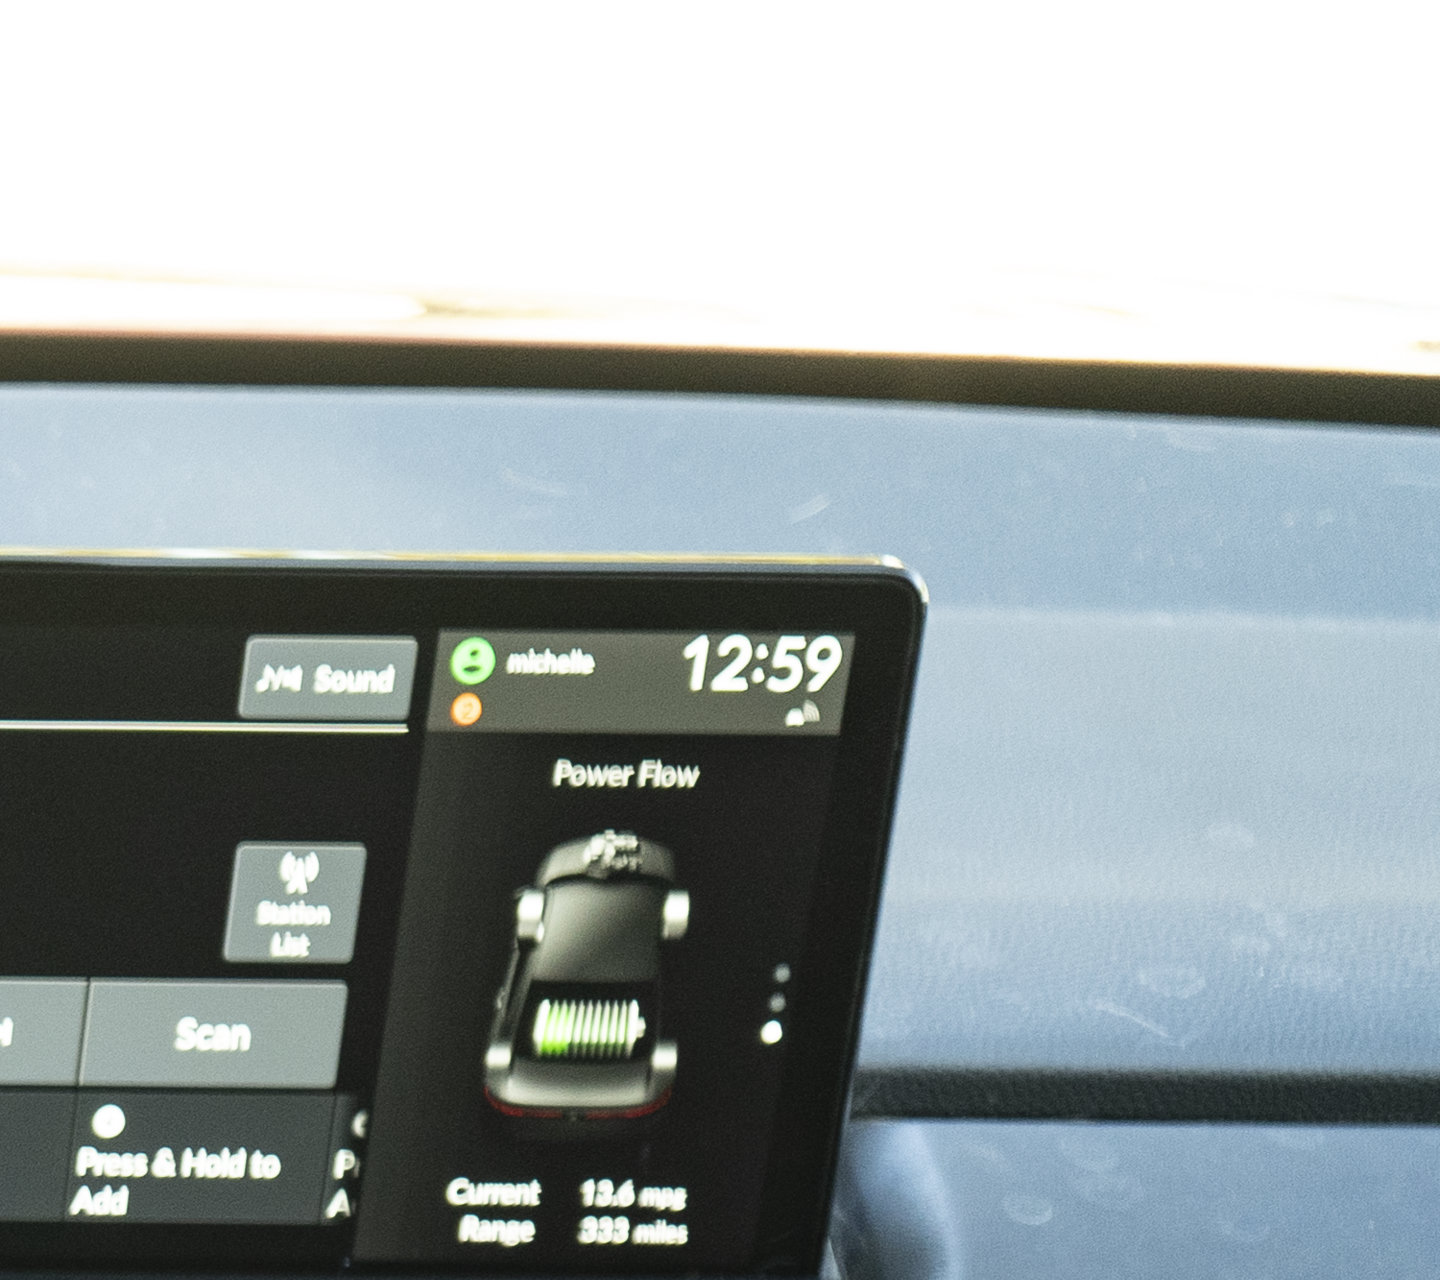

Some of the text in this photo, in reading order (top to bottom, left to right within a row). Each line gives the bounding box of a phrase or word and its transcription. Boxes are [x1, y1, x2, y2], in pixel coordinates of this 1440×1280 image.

[313, 664, 396, 694] Sound
[683, 634, 843, 693] 12:59
[552, 758, 701, 789] Power Flow
[174, 1016, 252, 1052] Scan
[75, 1145, 282, 1180] Press & Hold to
[68, 1184, 130, 1217] Add
[445, 1176, 542, 1207] Current
[457, 1213, 536, 1247] Range
[631, 1219, 689, 1245] miles
